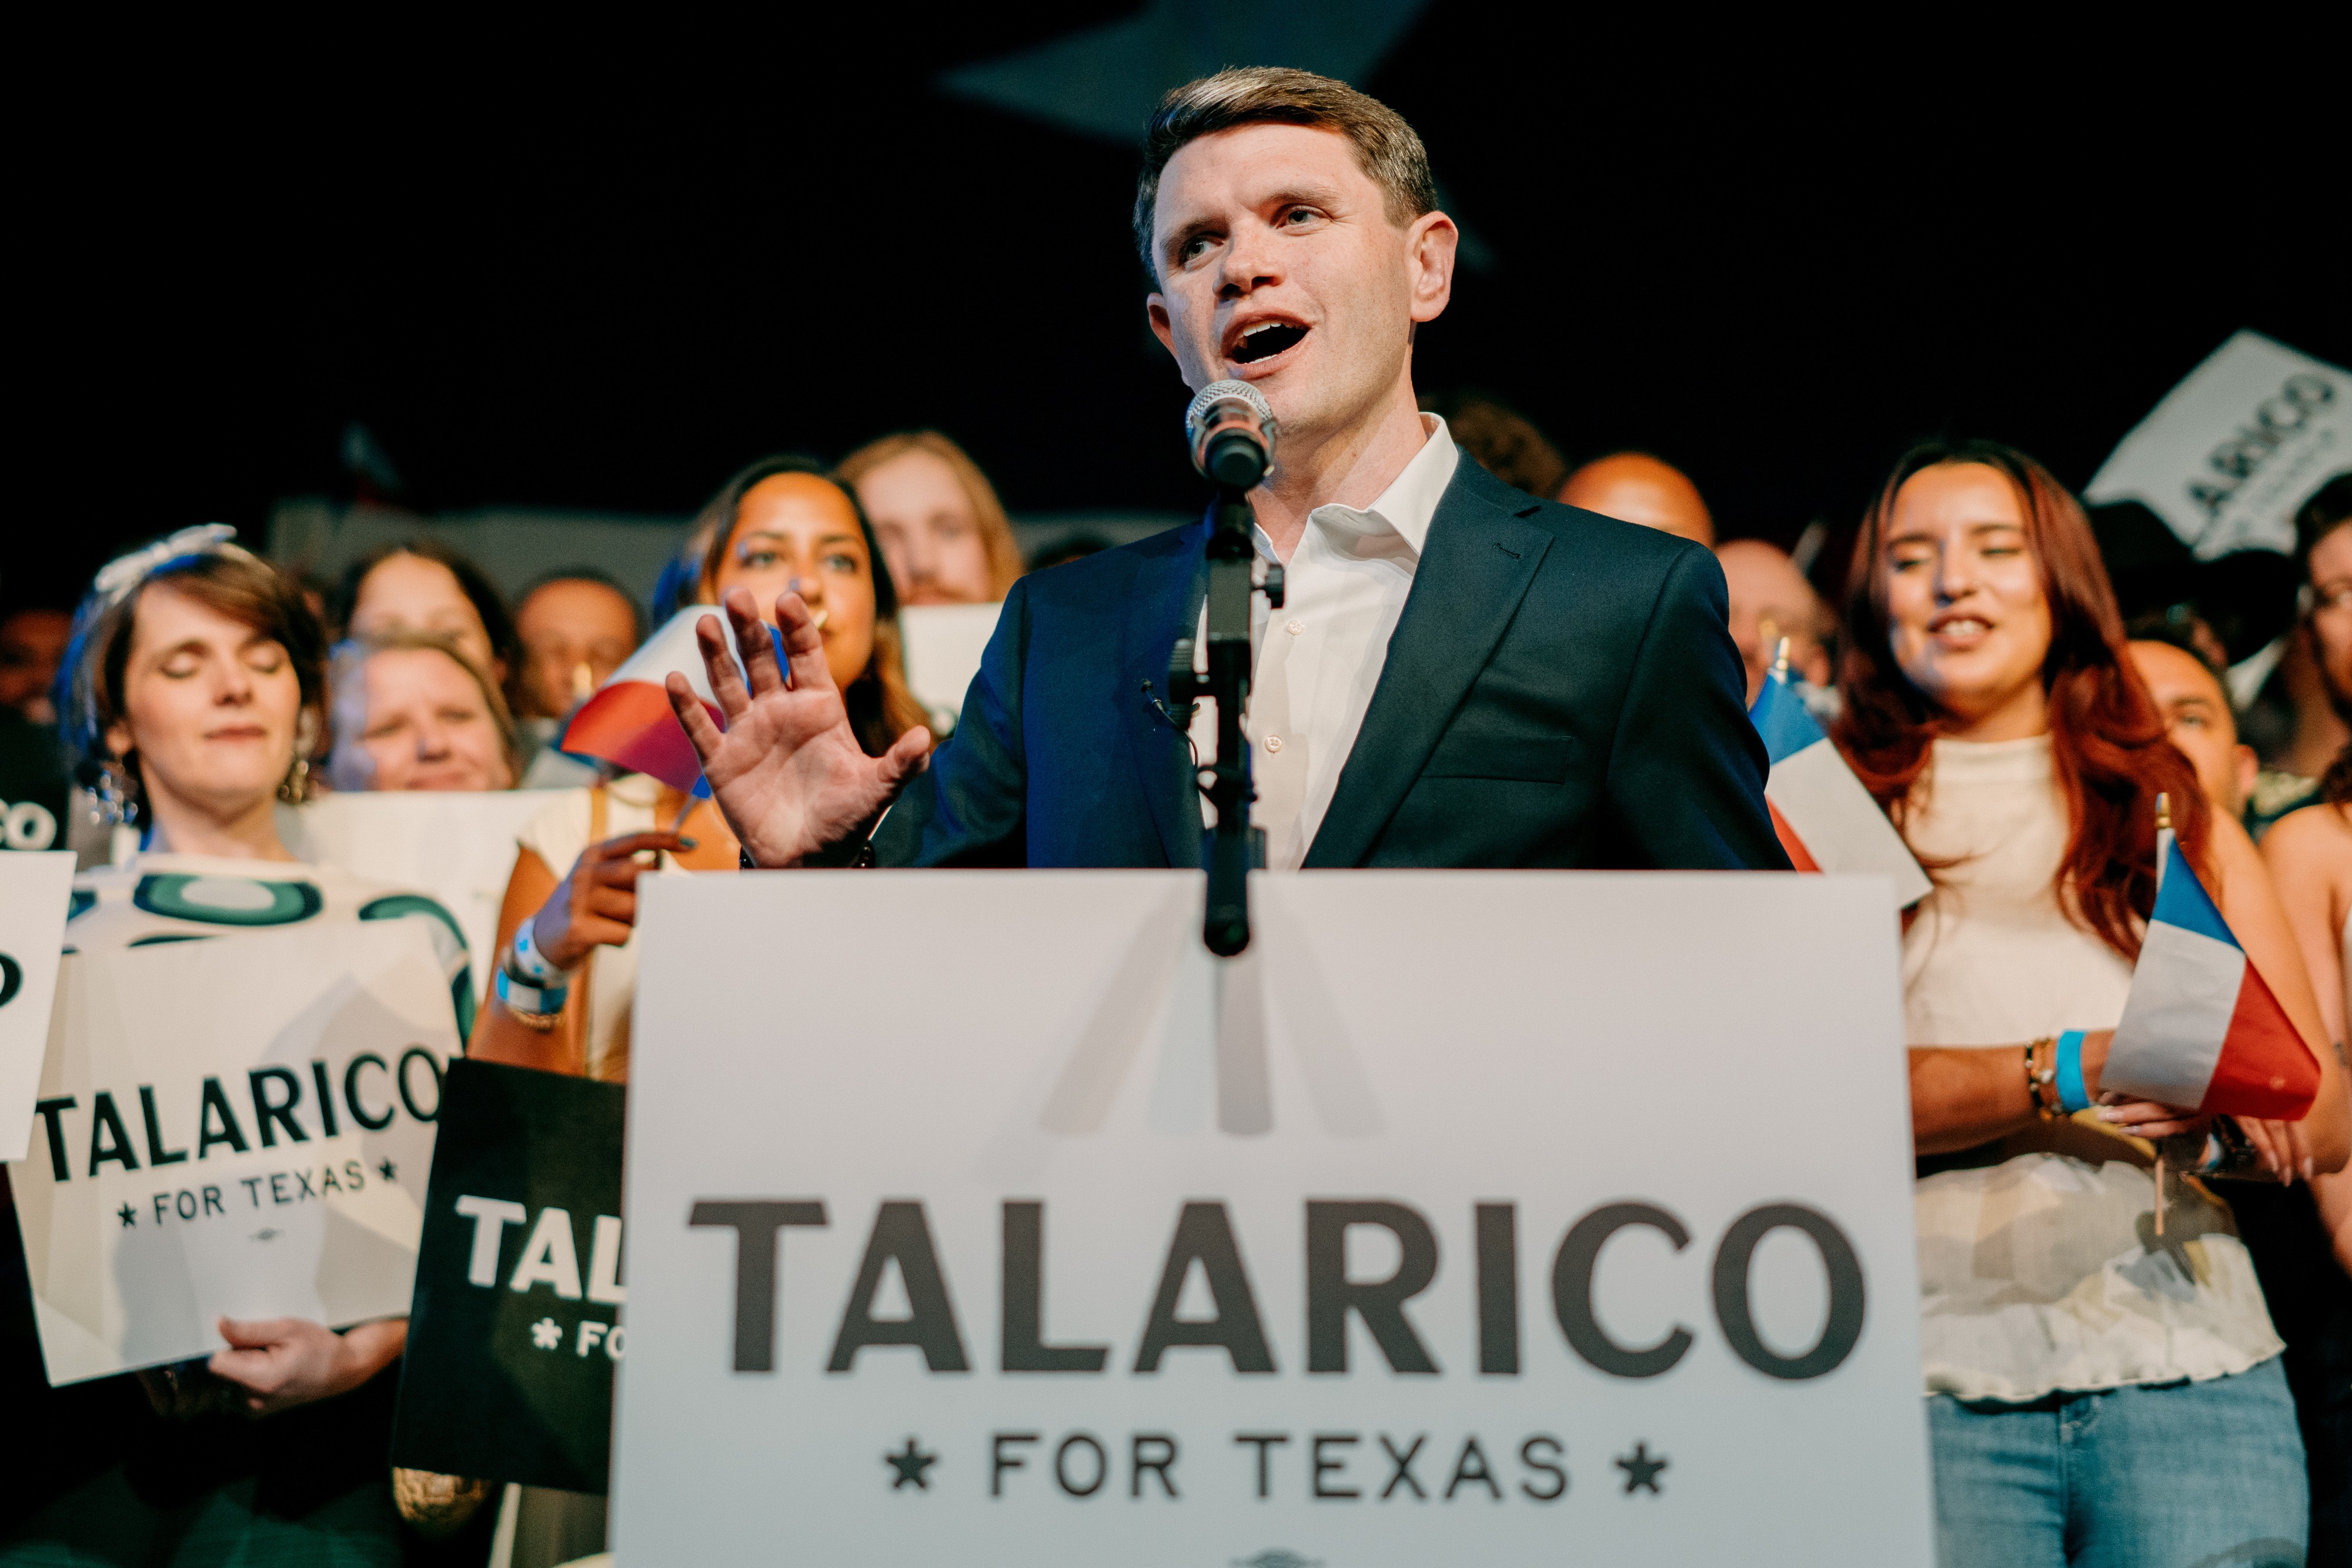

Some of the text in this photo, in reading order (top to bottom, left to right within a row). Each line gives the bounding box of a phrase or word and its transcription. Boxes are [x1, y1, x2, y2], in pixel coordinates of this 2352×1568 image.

[34, 1047, 441, 1182] TALARICO
[153, 1160, 366, 1224] FOR TEXAS
[687, 1198, 1867, 1383] TALARICO
[990, 1432, 1569, 1503] FOR TEXAS
